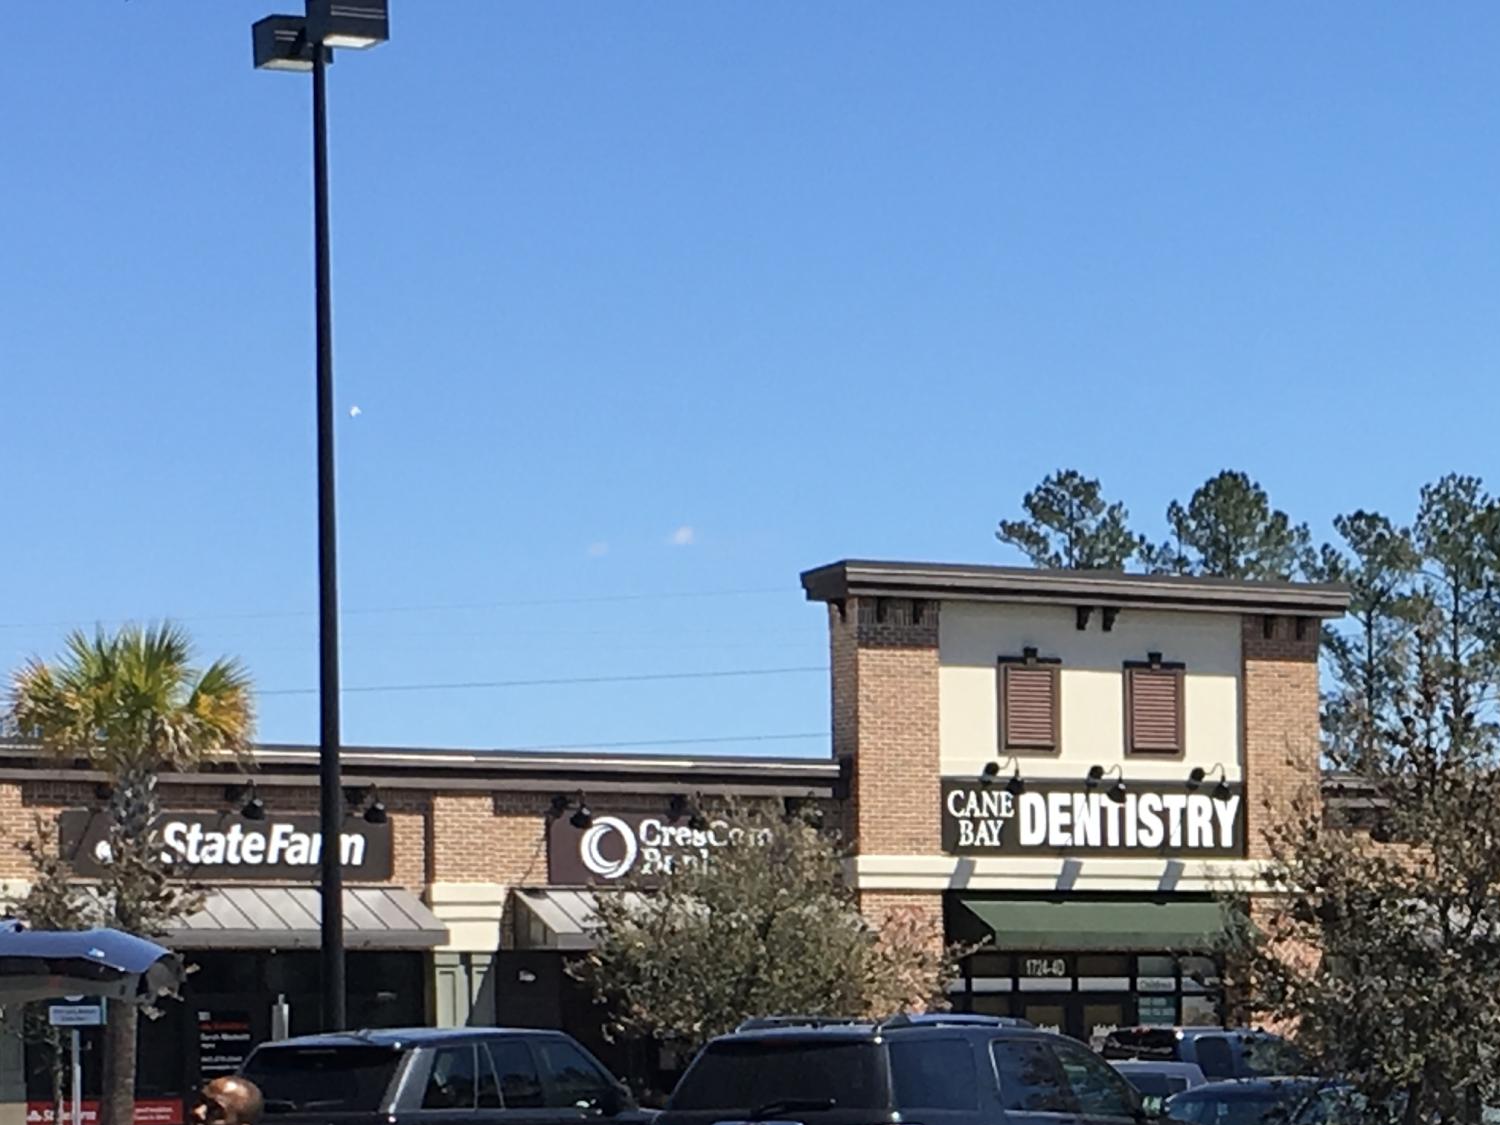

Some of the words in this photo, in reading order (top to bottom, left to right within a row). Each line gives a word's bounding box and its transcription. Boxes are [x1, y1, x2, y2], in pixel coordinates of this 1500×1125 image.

[947, 790, 1015, 818] CANE
[958, 820, 1004, 847] BAY
[1019, 792, 1240, 848] DENTISTRY
